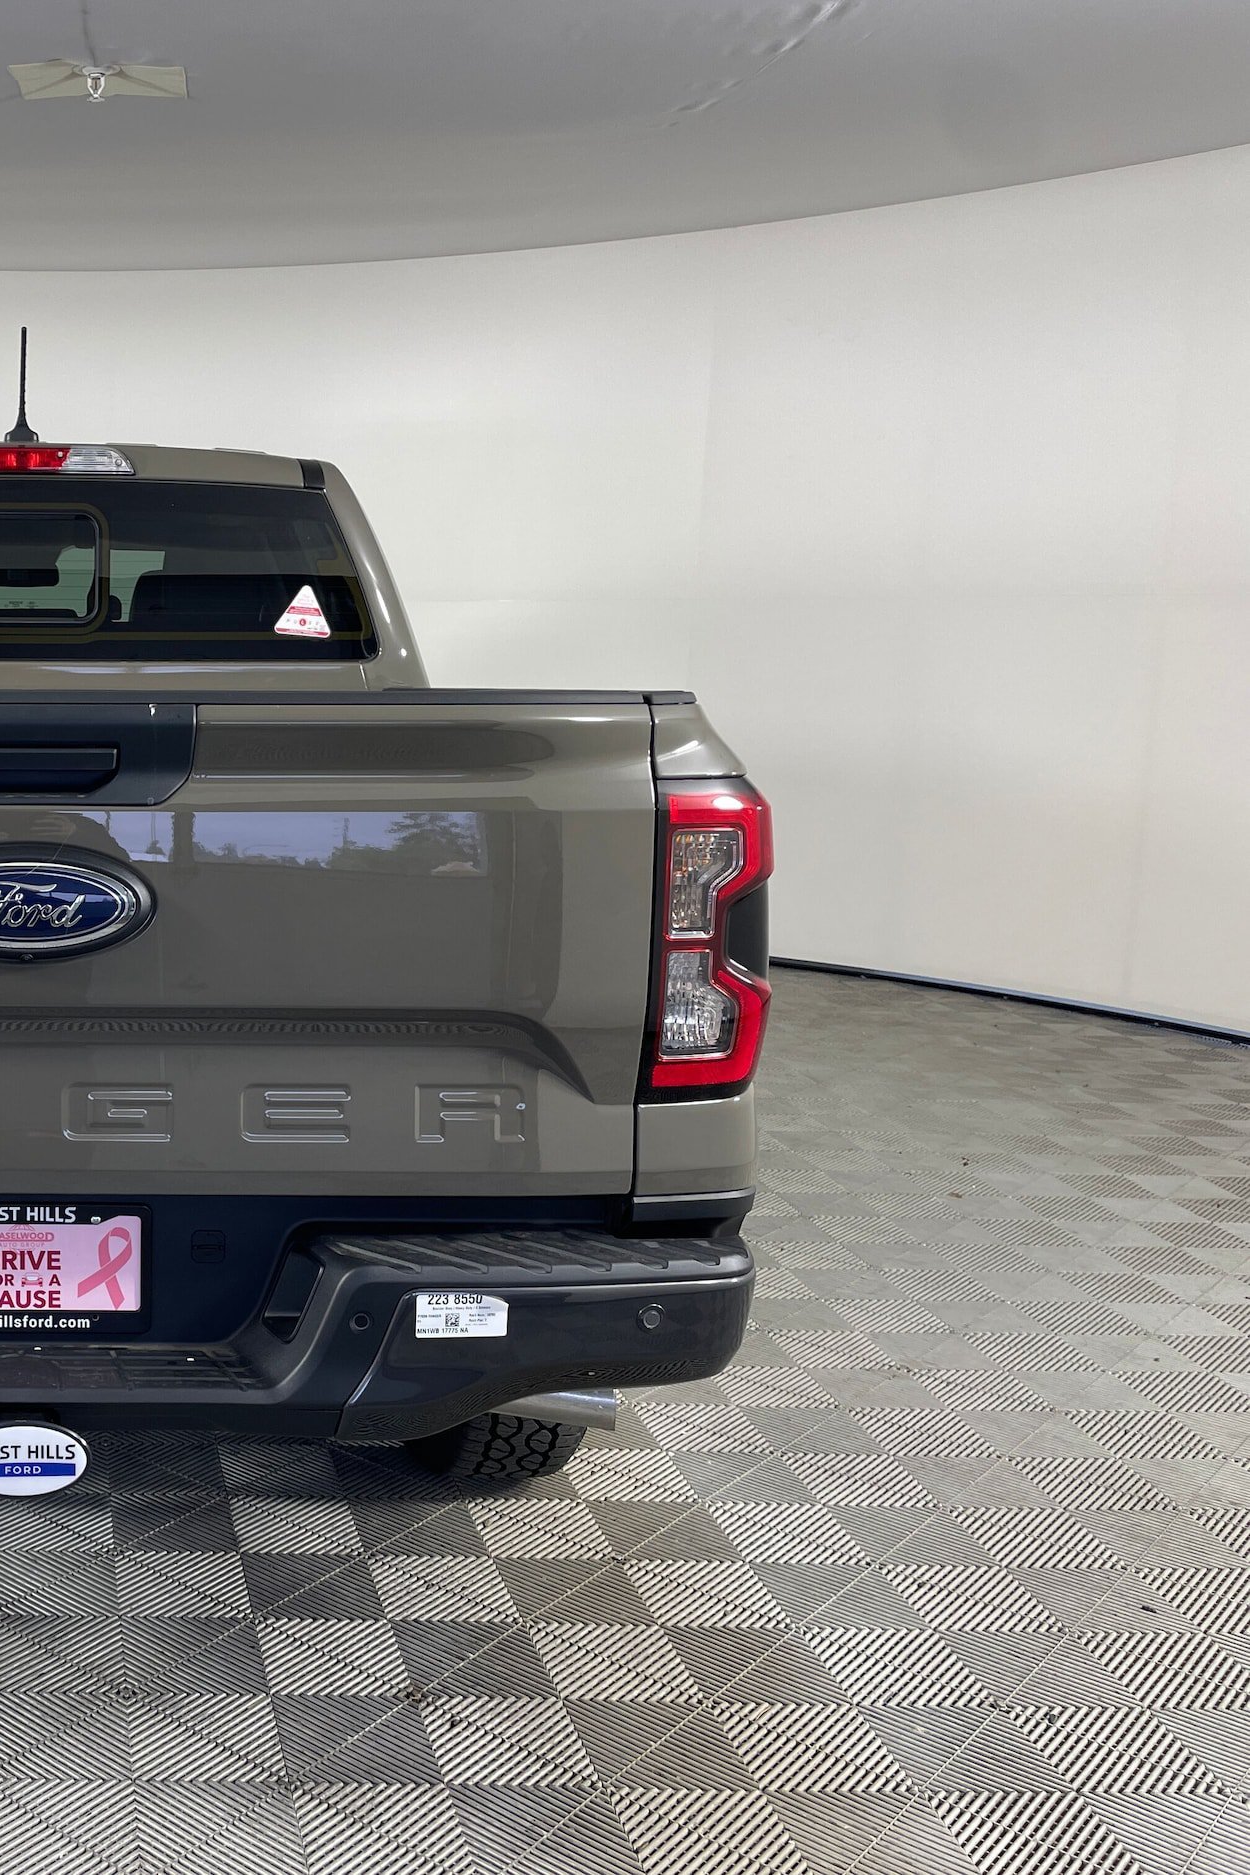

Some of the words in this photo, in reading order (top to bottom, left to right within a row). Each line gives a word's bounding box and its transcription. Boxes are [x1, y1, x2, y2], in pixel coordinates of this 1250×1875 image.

[26, 1206, 77, 1223] HILLS
[48, 1274, 62, 1286] A
[427, 1294, 449, 1305] 223
[454, 1293, 483, 1305] 8550
[27, 1444, 76, 1460] HILLS
[4, 1466, 42, 1475] FORD
